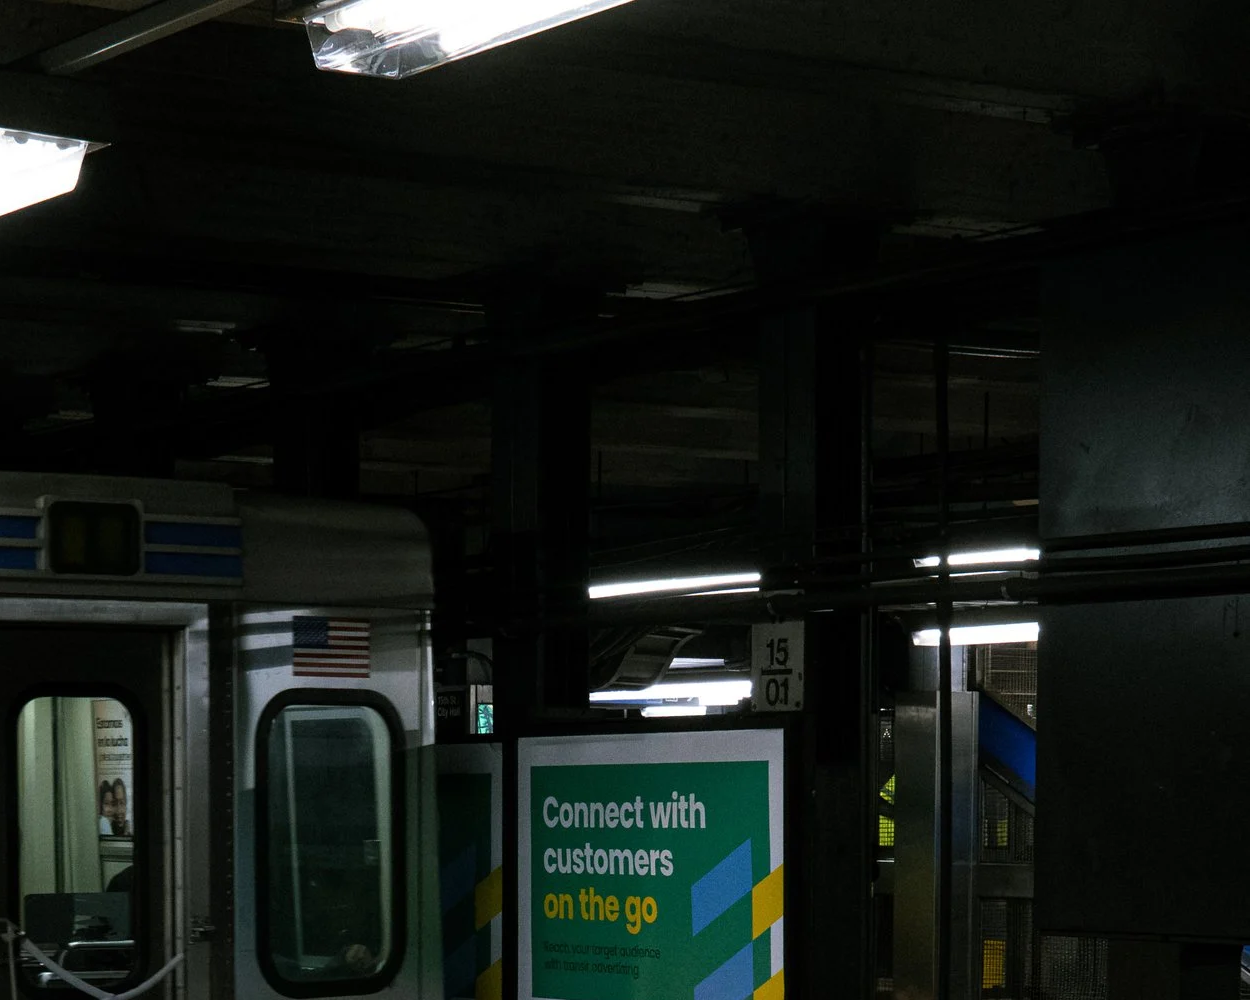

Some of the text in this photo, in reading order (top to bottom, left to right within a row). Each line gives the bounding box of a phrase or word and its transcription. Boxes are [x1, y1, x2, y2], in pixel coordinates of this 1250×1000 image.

[766, 638, 789, 667] 15
[766, 678, 789, 706] 01
[543, 790, 706, 829] Connect with
[543, 842, 674, 877] customers
[543, 887, 658, 935] on the go
